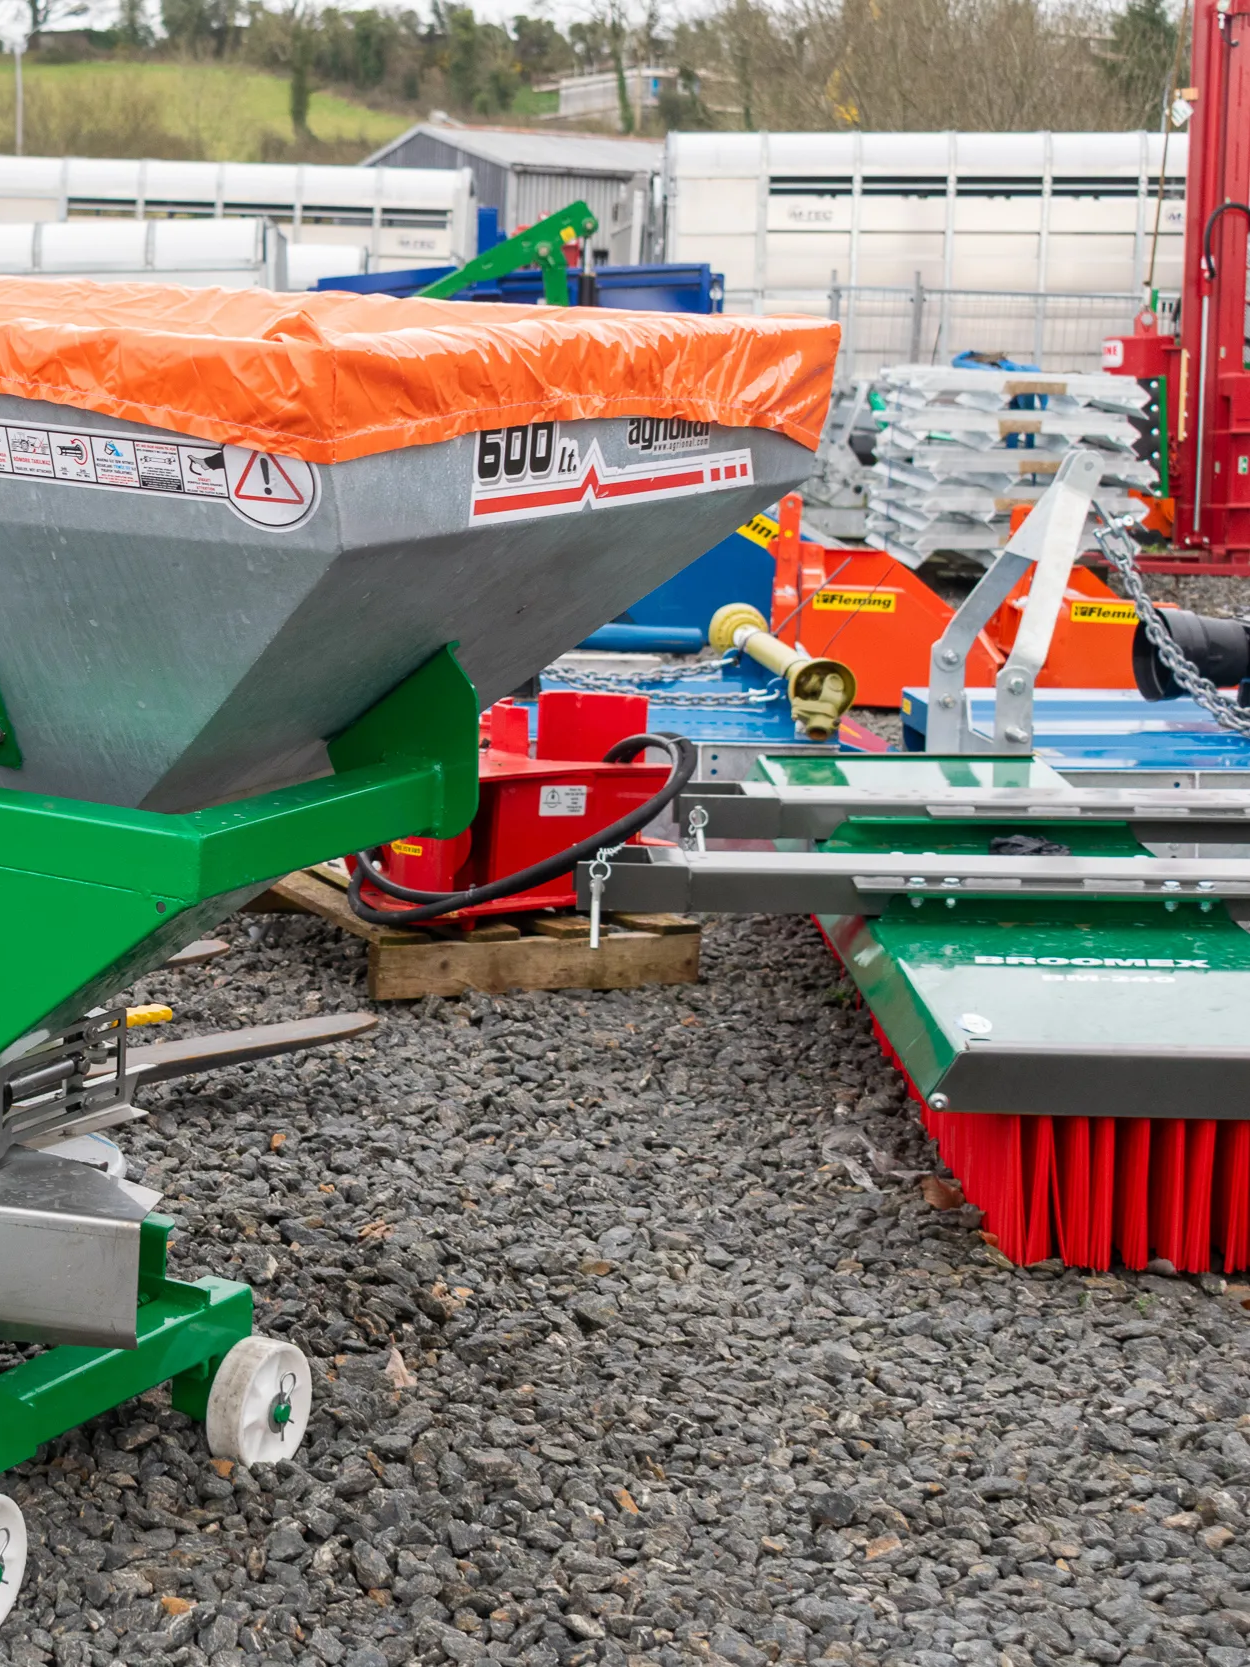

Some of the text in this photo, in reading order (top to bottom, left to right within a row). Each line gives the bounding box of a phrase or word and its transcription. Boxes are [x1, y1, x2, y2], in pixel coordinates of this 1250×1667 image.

[477, 421, 555, 479] 600
[653, 438, 709, 452] www.agrional.com
[829, 594, 892, 609] Fleming
[1089, 606, 1140, 619] Flemi
[974, 955, 1211, 969] BROOMEX
[1041, 974, 1176, 984] BM-240
